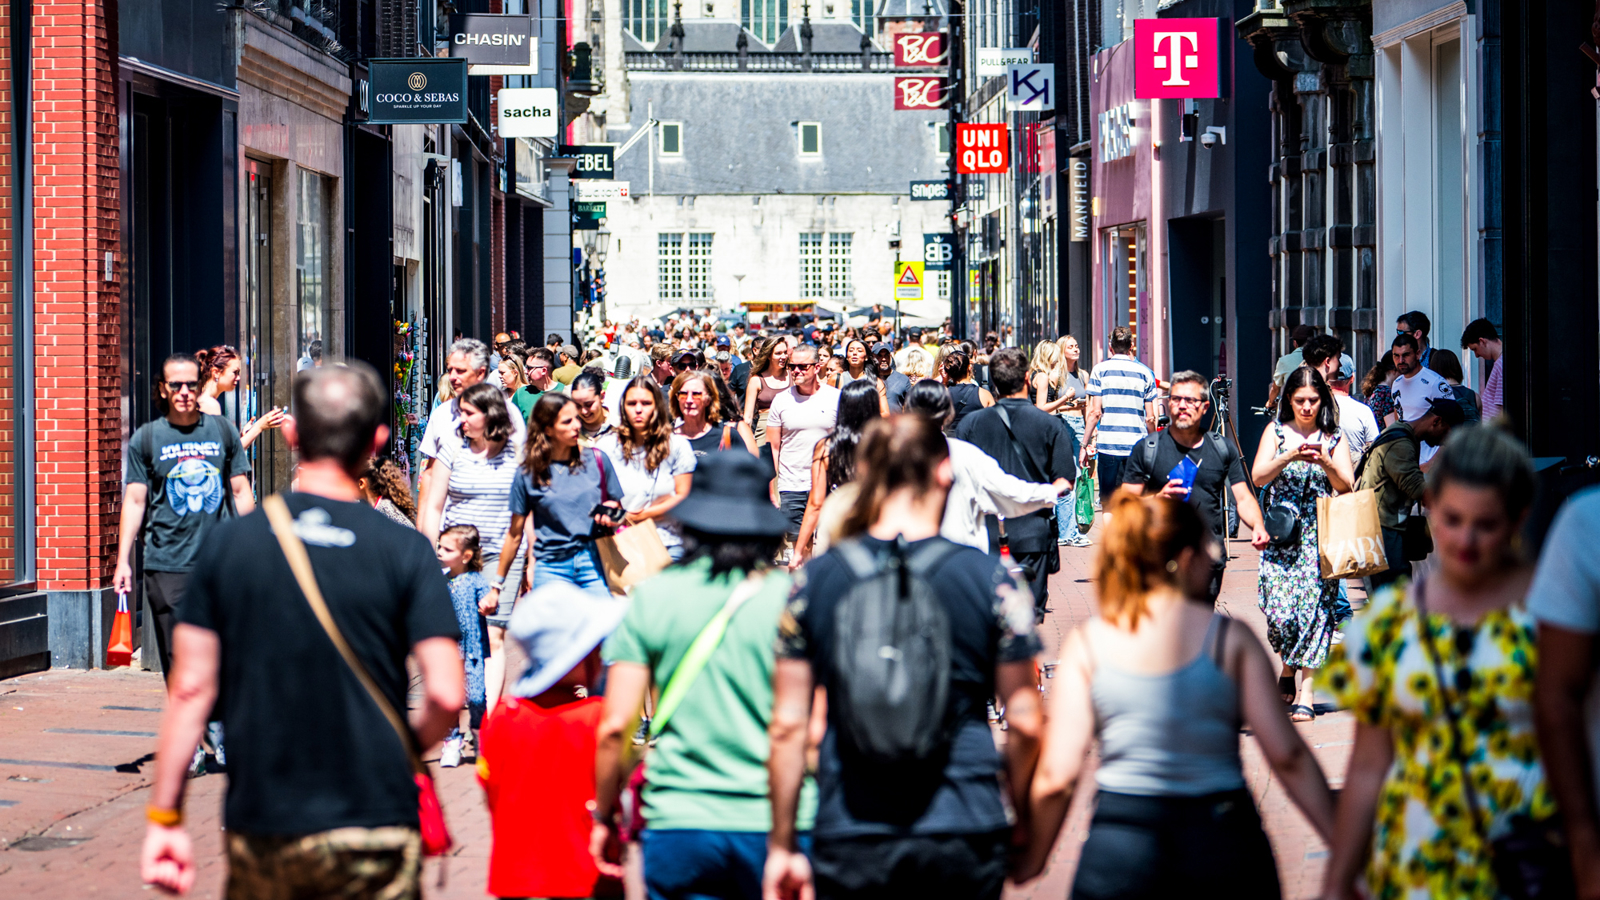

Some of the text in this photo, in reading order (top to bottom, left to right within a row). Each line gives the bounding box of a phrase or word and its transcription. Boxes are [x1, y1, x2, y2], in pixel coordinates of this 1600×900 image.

[454, 33, 526, 46] CHASIN'
[376, 92, 460, 103] COCO & SEBAS
[503, 106, 551, 118] sacha
[963, 129, 999, 148] UNI
[963, 150, 1002, 171] QLO
[911, 183, 948, 199] snipes
[1074, 161, 1088, 238] MANFIELD
[160, 441, 220, 461] JOURNEY
